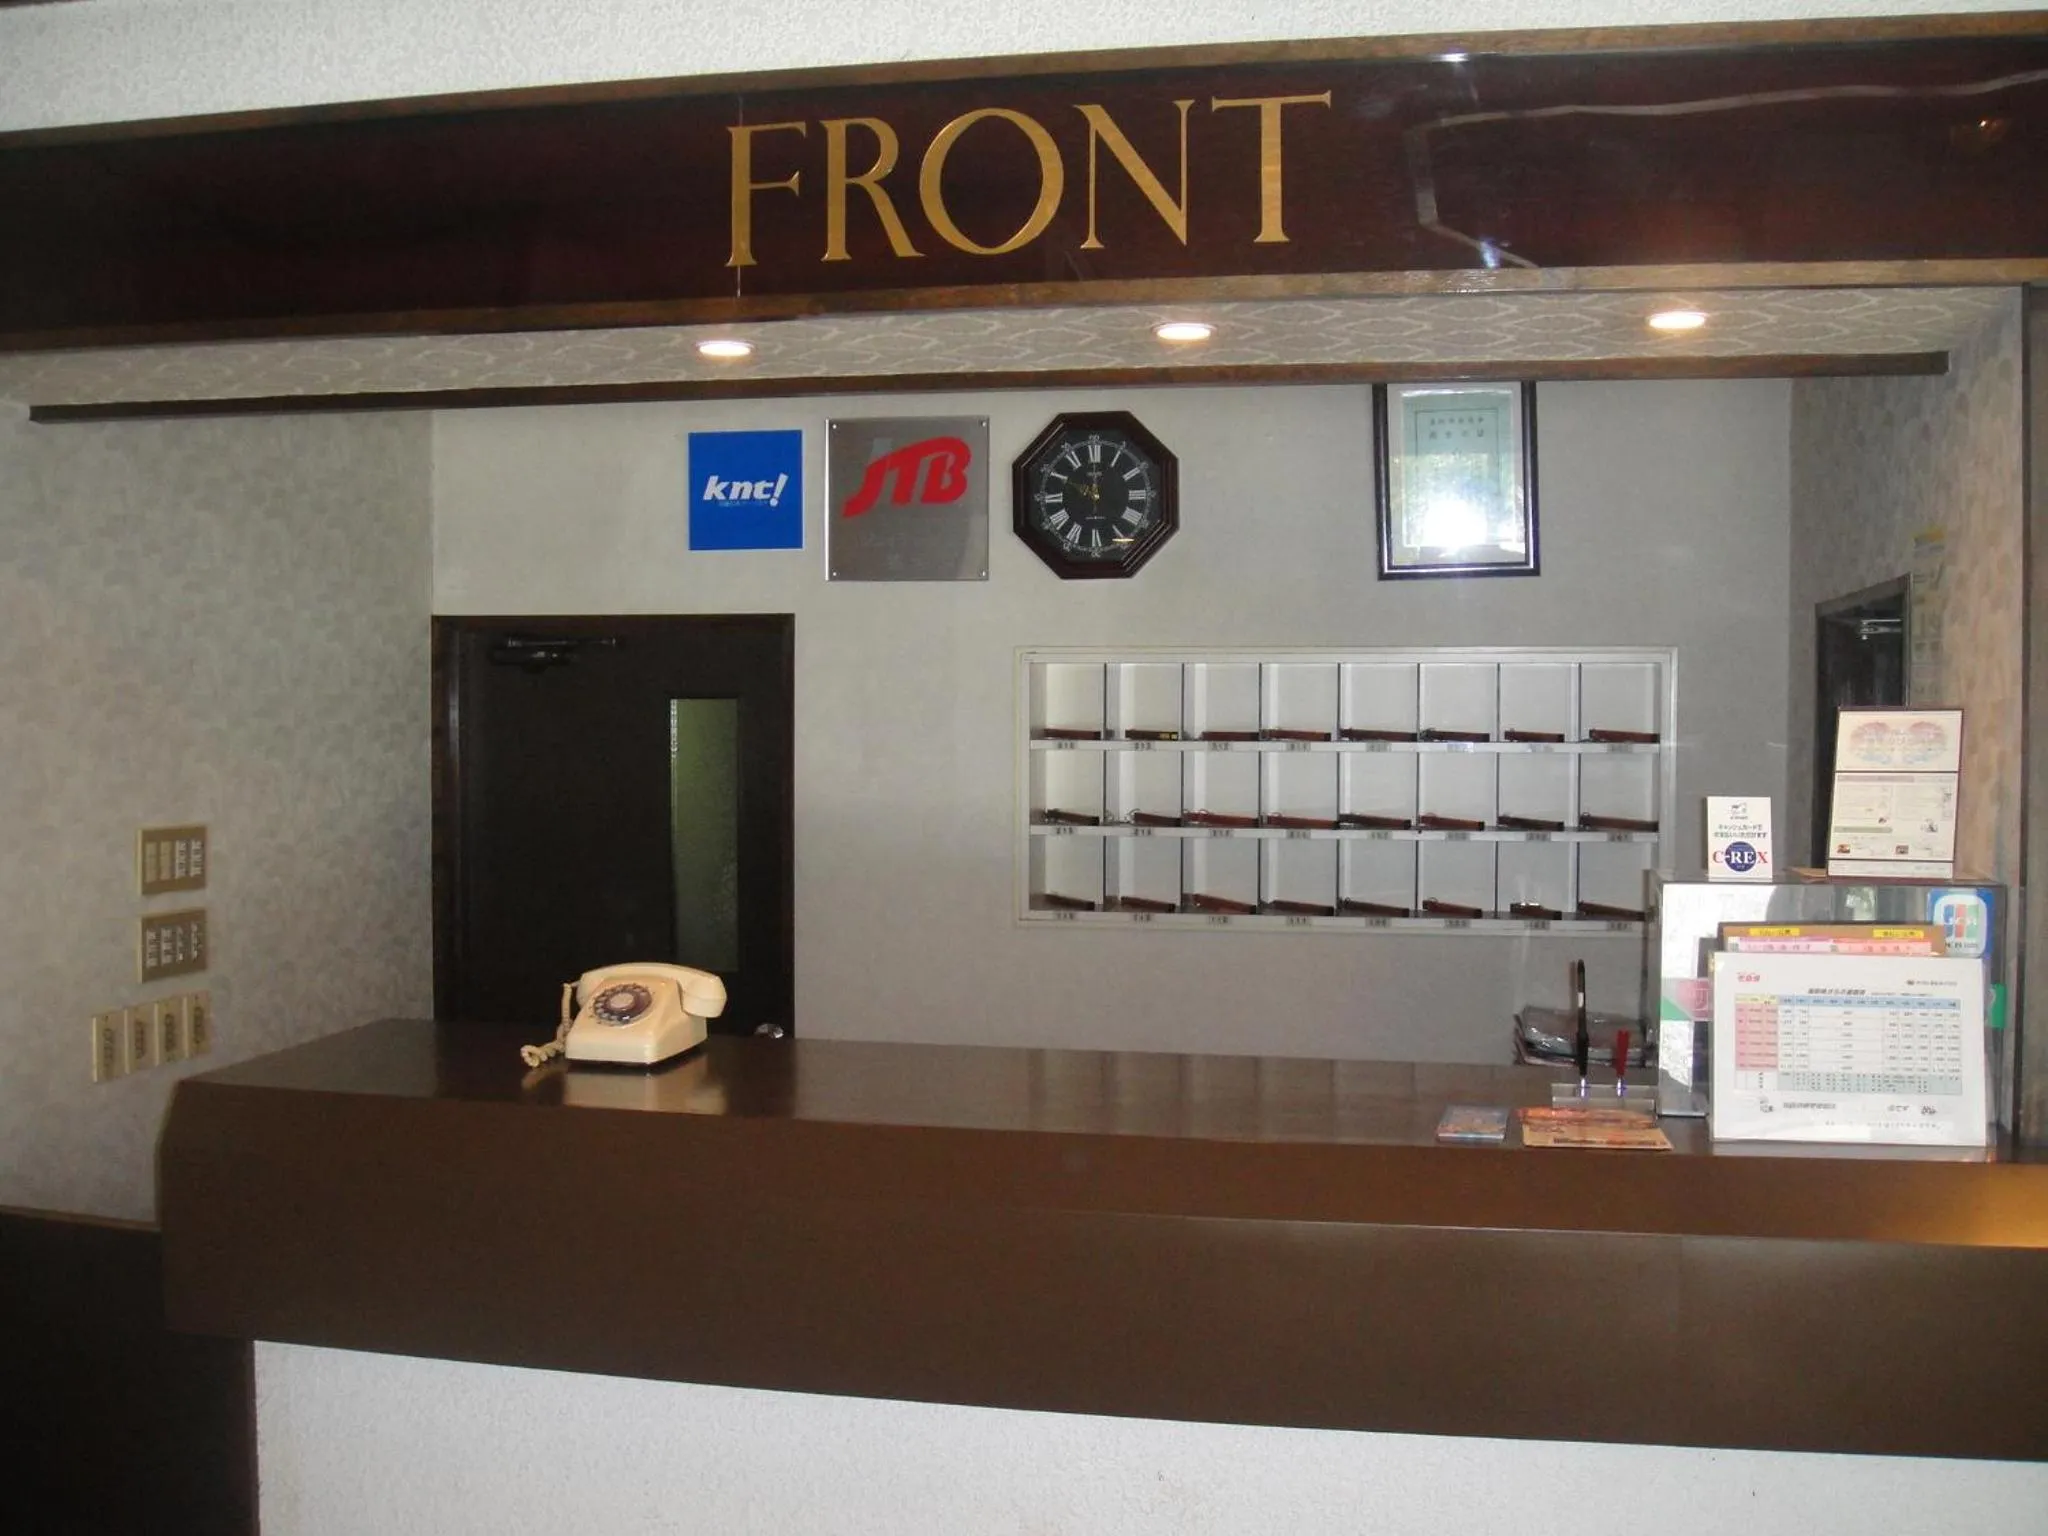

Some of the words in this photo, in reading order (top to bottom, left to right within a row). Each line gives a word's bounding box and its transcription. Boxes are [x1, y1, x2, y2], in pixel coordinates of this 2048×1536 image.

[726, 90, 1332, 267] FRONT
[842, 435, 971, 518] JTB
[1712, 850, 1768, 864] C-REX
